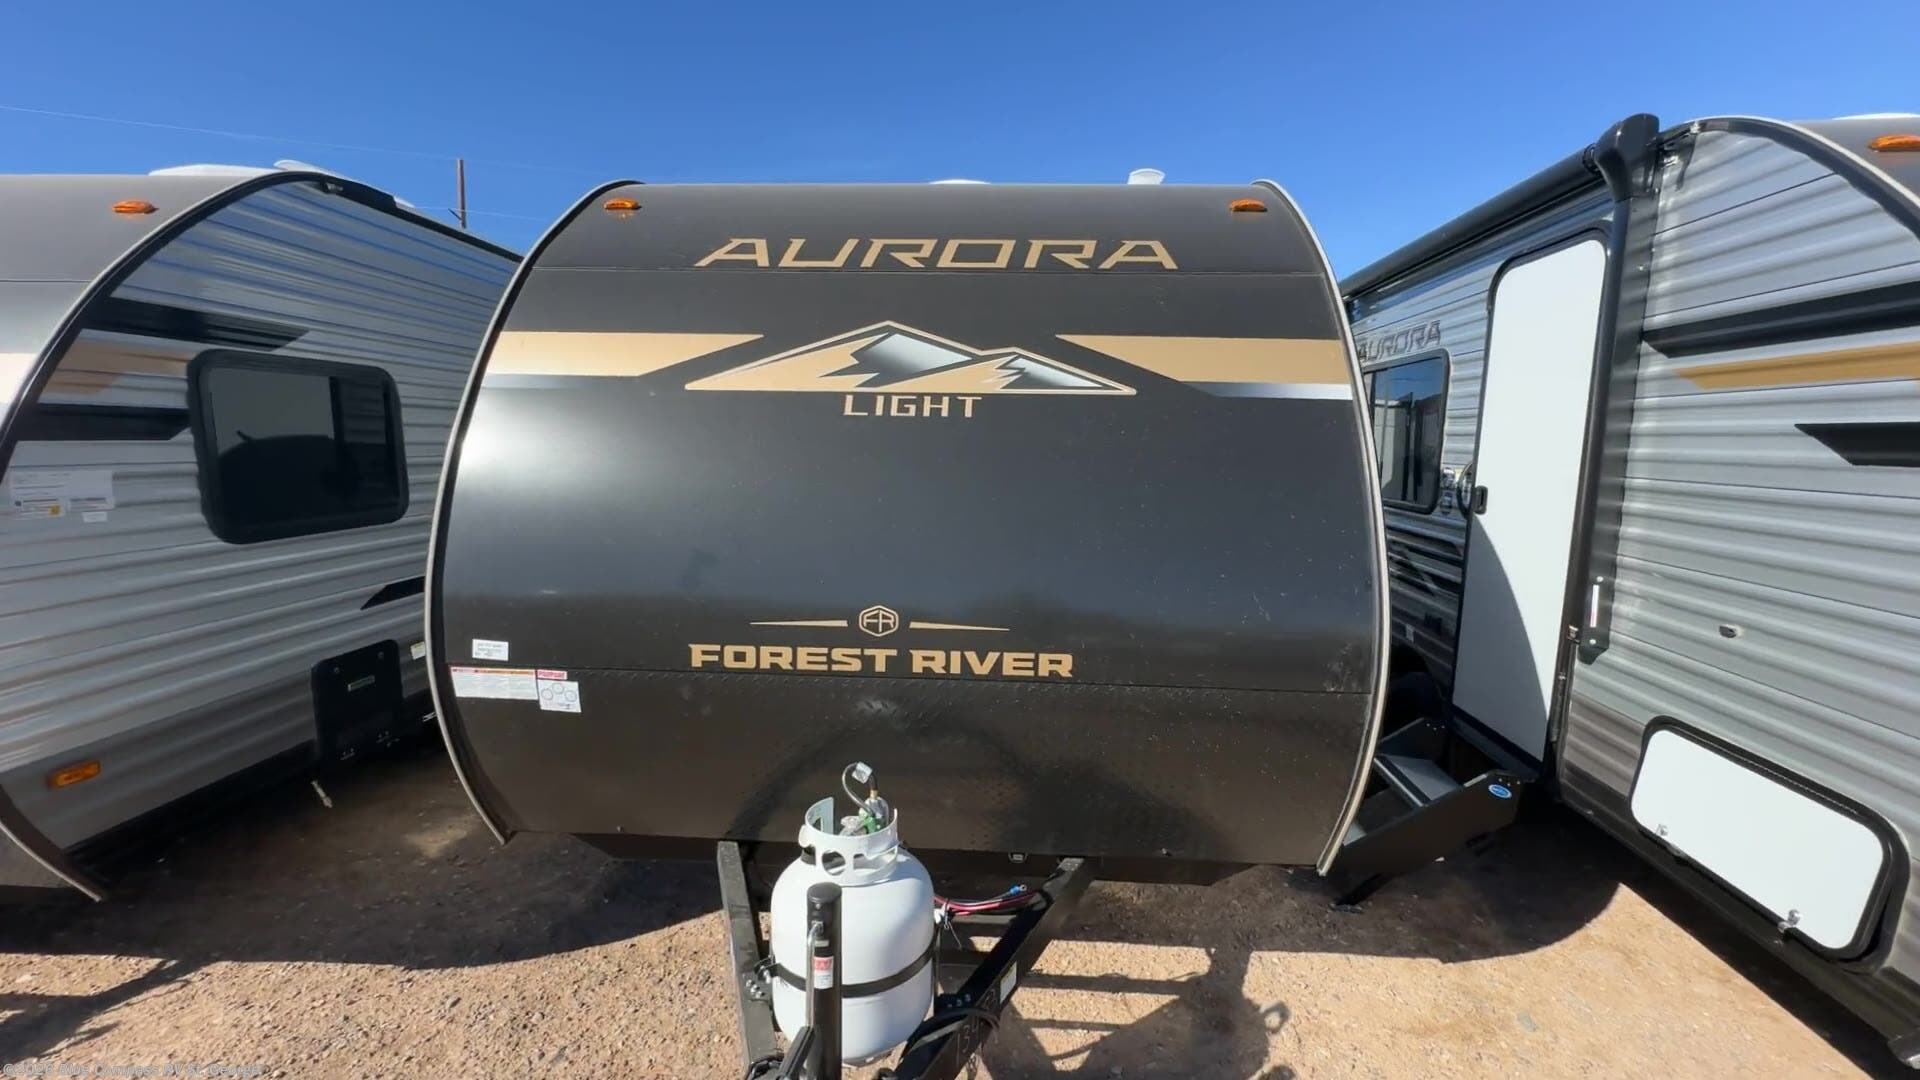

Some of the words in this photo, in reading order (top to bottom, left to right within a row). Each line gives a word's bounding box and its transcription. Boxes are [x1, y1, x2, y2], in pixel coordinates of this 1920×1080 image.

[694, 238, 1179, 270] AURORA
[843, 394, 983, 418] LIGHT
[688, 643, 898, 673] FOREST
[909, 649, 1074, 678] RIVER
